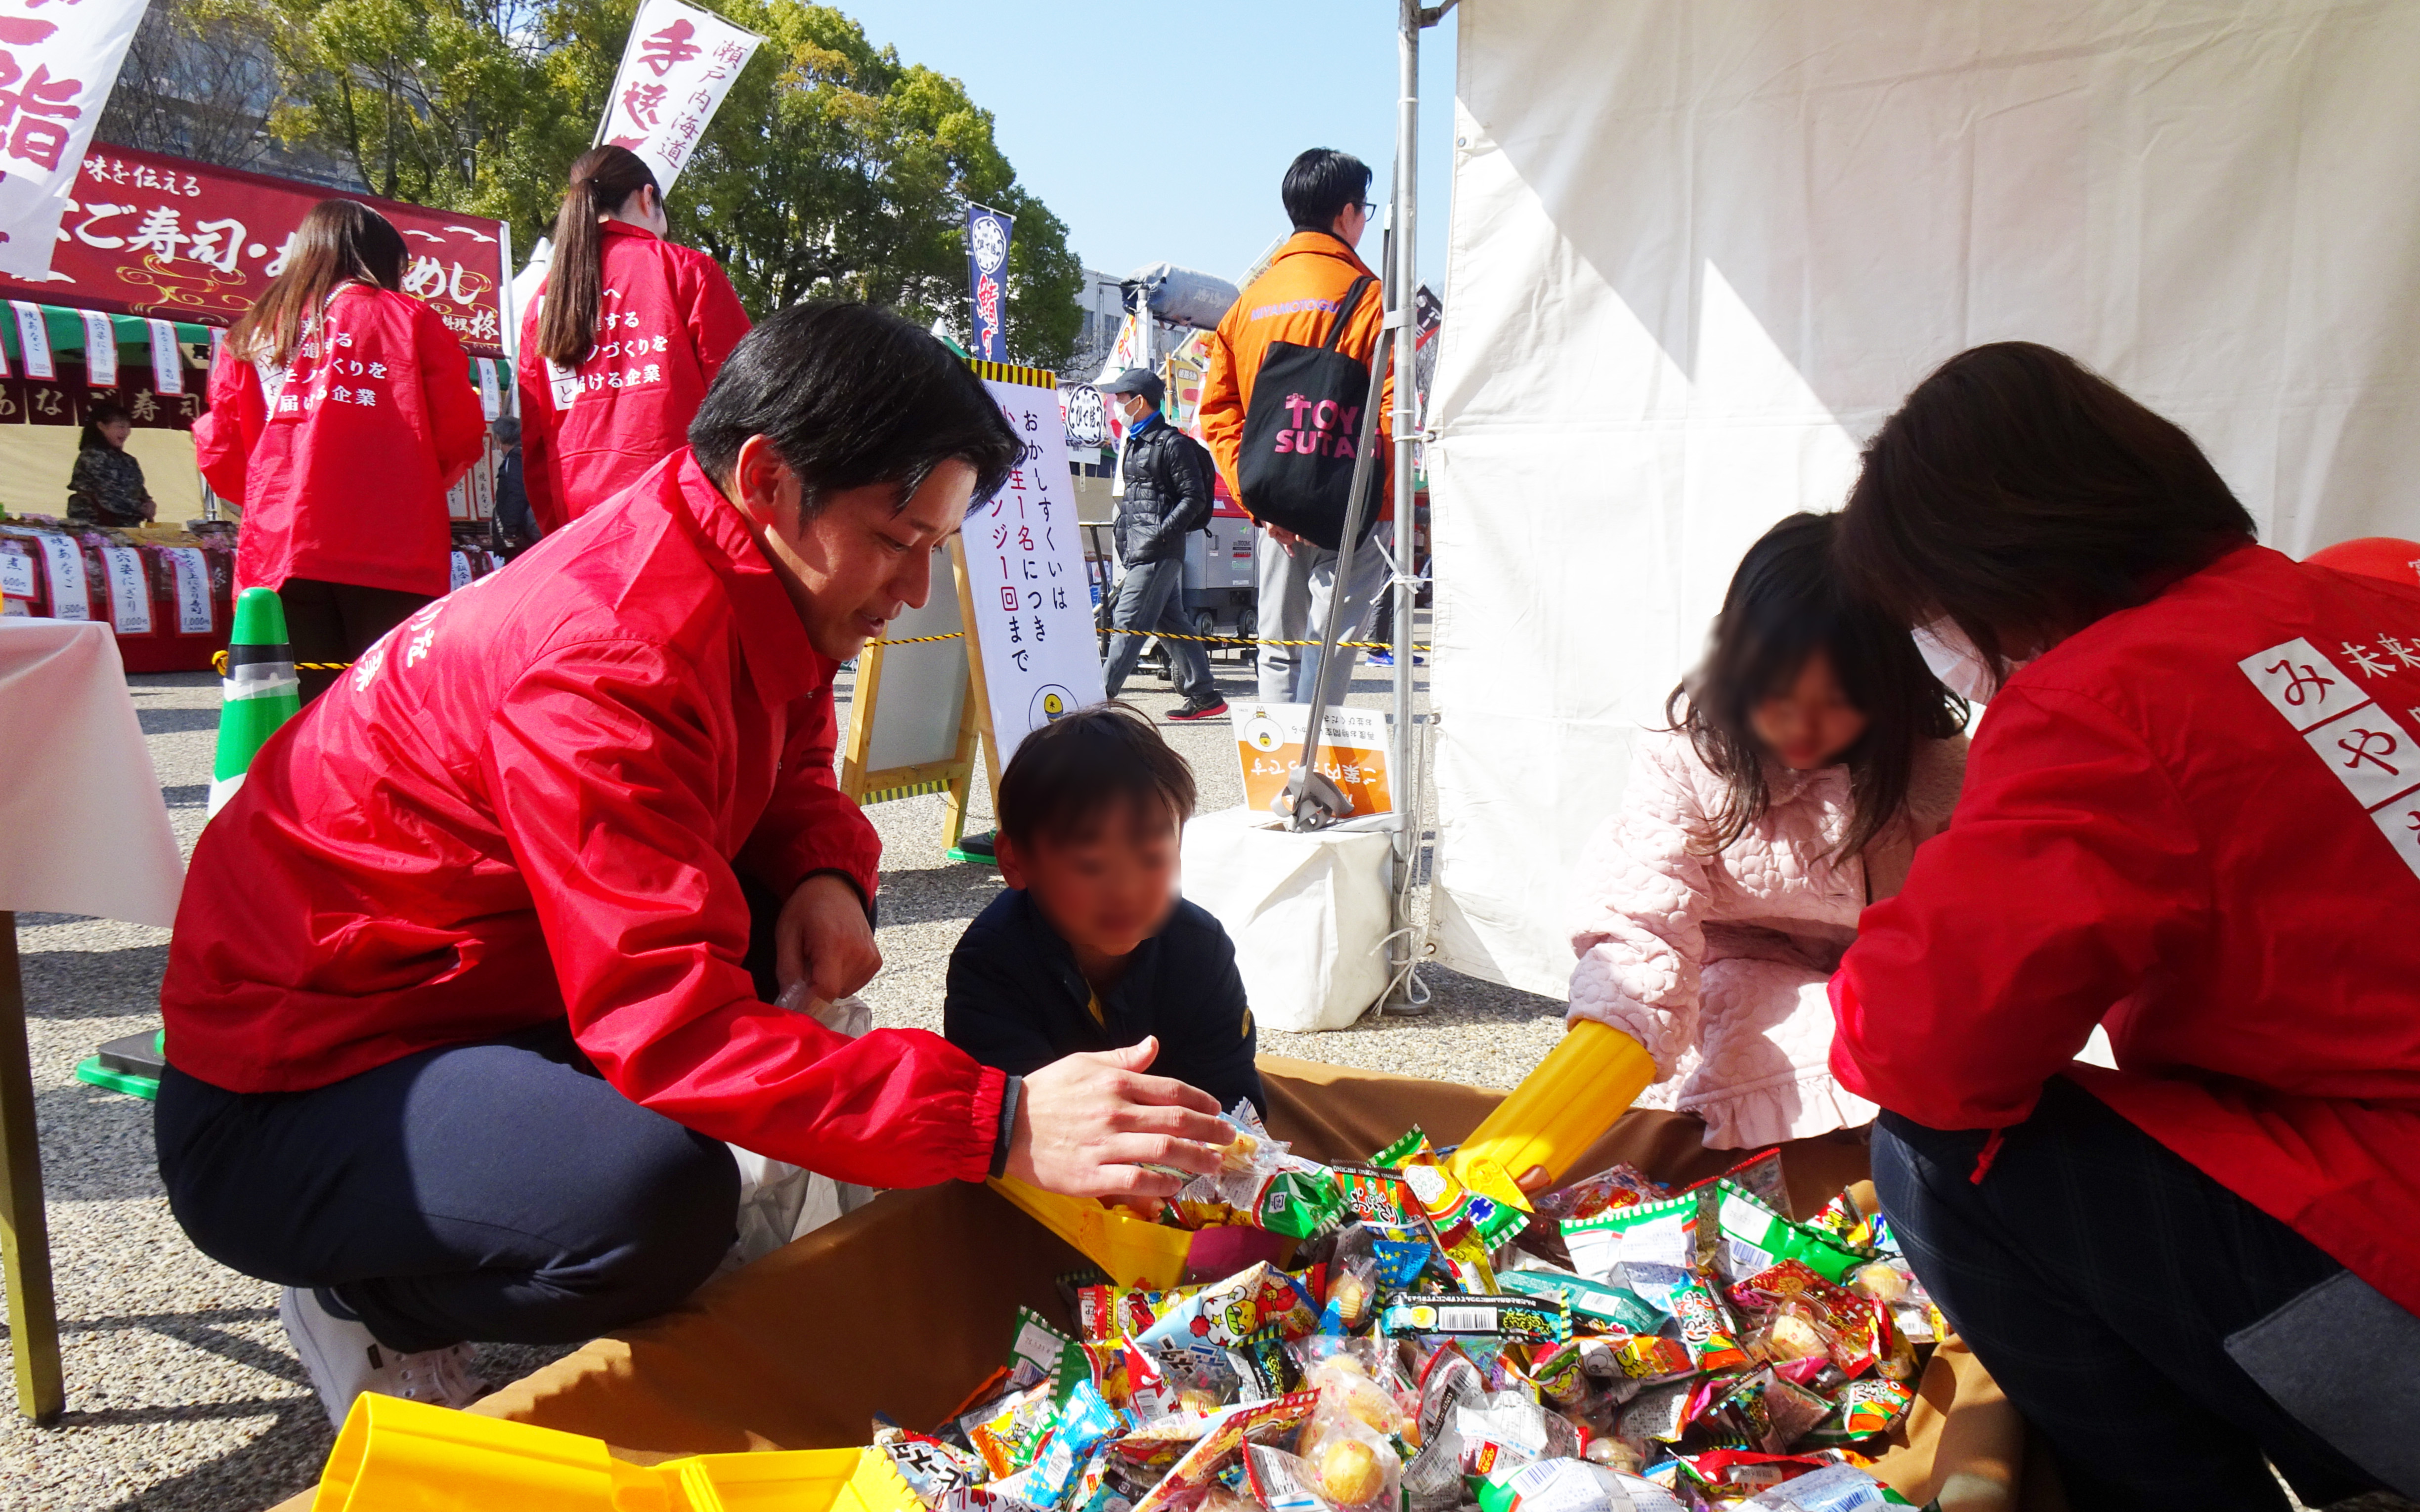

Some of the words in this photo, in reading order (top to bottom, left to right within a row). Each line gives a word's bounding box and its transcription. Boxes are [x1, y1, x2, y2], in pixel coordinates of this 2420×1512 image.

[656, 40, 748, 169] 瀬戸内海道
[83, 155, 201, 197] 味を伝える
[598, 311, 639, 331] する
[1286, 399, 1359, 434] TOY
[1023, 409, 1068, 610] おかしすくいは
[2340, 632, 2420, 679] 未来
[1324, 714, 1372, 726] お並びくださ
[2265, 659, 2420, 845] みや
[1333, 1165, 1357, 1174] ONIGIRI
[1350, 1186, 1400, 1225] おにぎり
